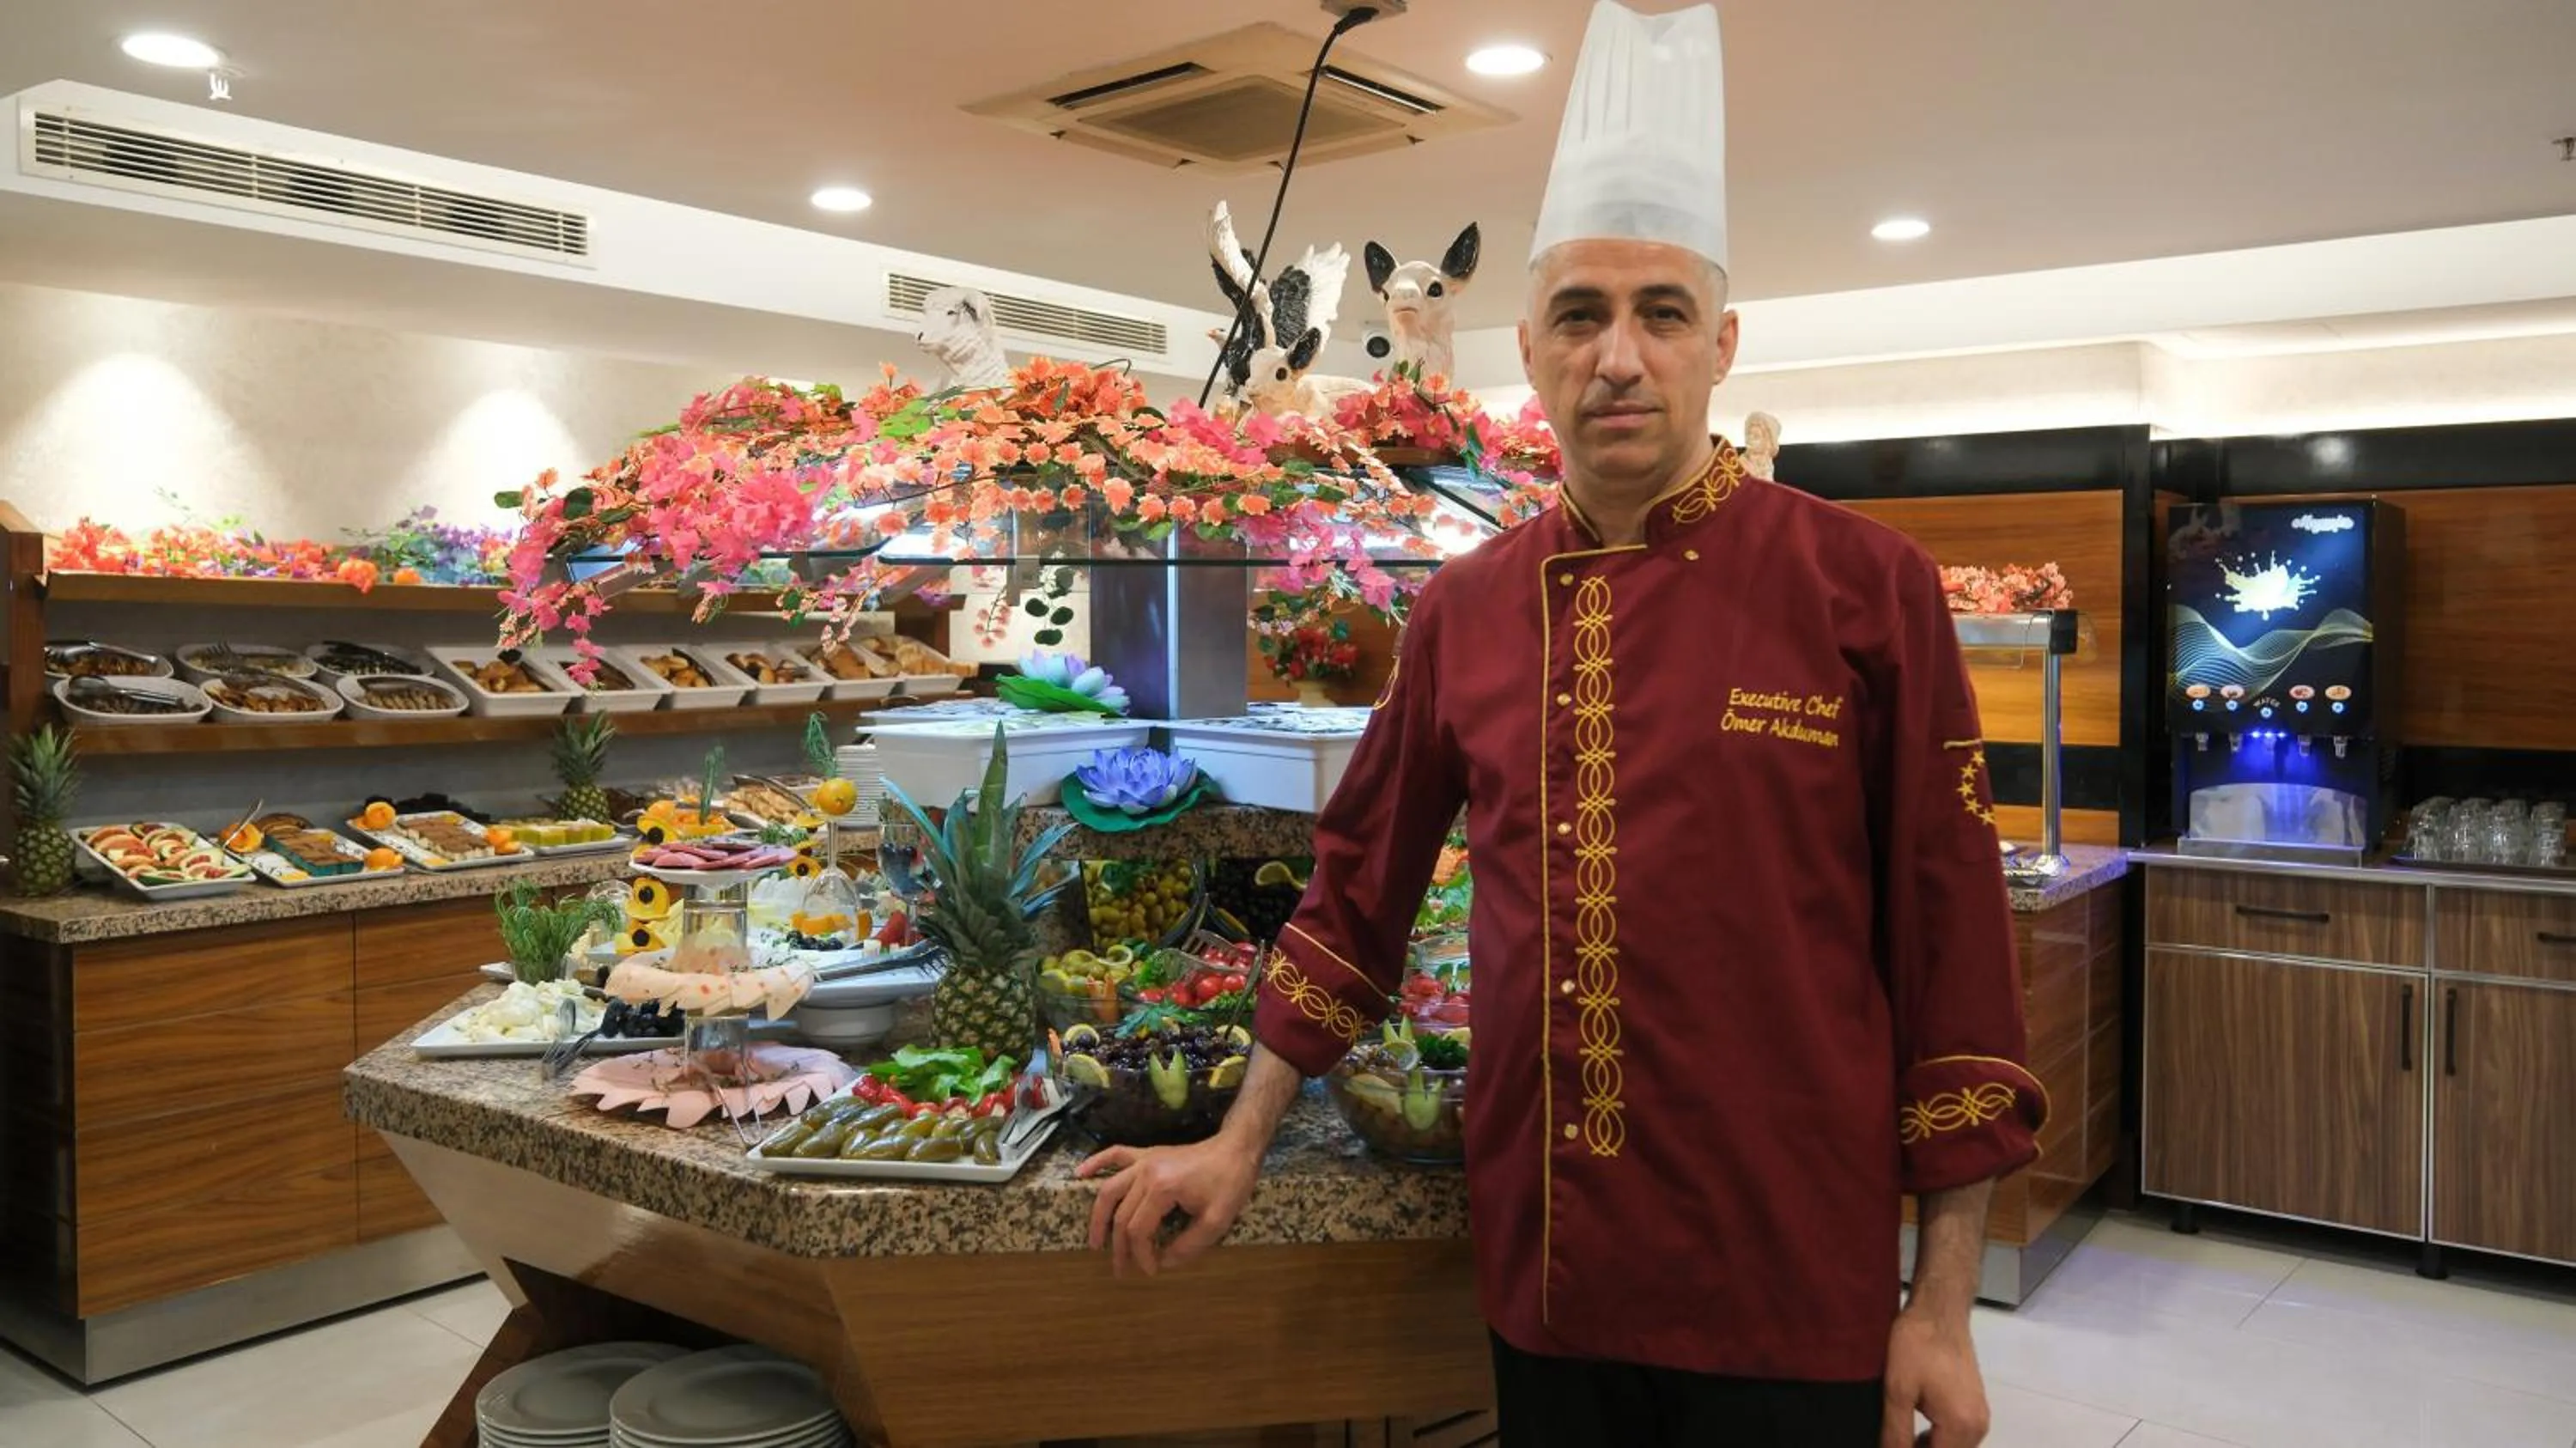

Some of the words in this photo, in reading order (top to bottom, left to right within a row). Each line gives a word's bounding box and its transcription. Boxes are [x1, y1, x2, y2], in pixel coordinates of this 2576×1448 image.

[1728, 688, 1801, 712] Executive
[1805, 695, 1844, 719] Chef
[1721, 708, 1767, 733] Ömer
[1769, 718, 1838, 747] Akduman
